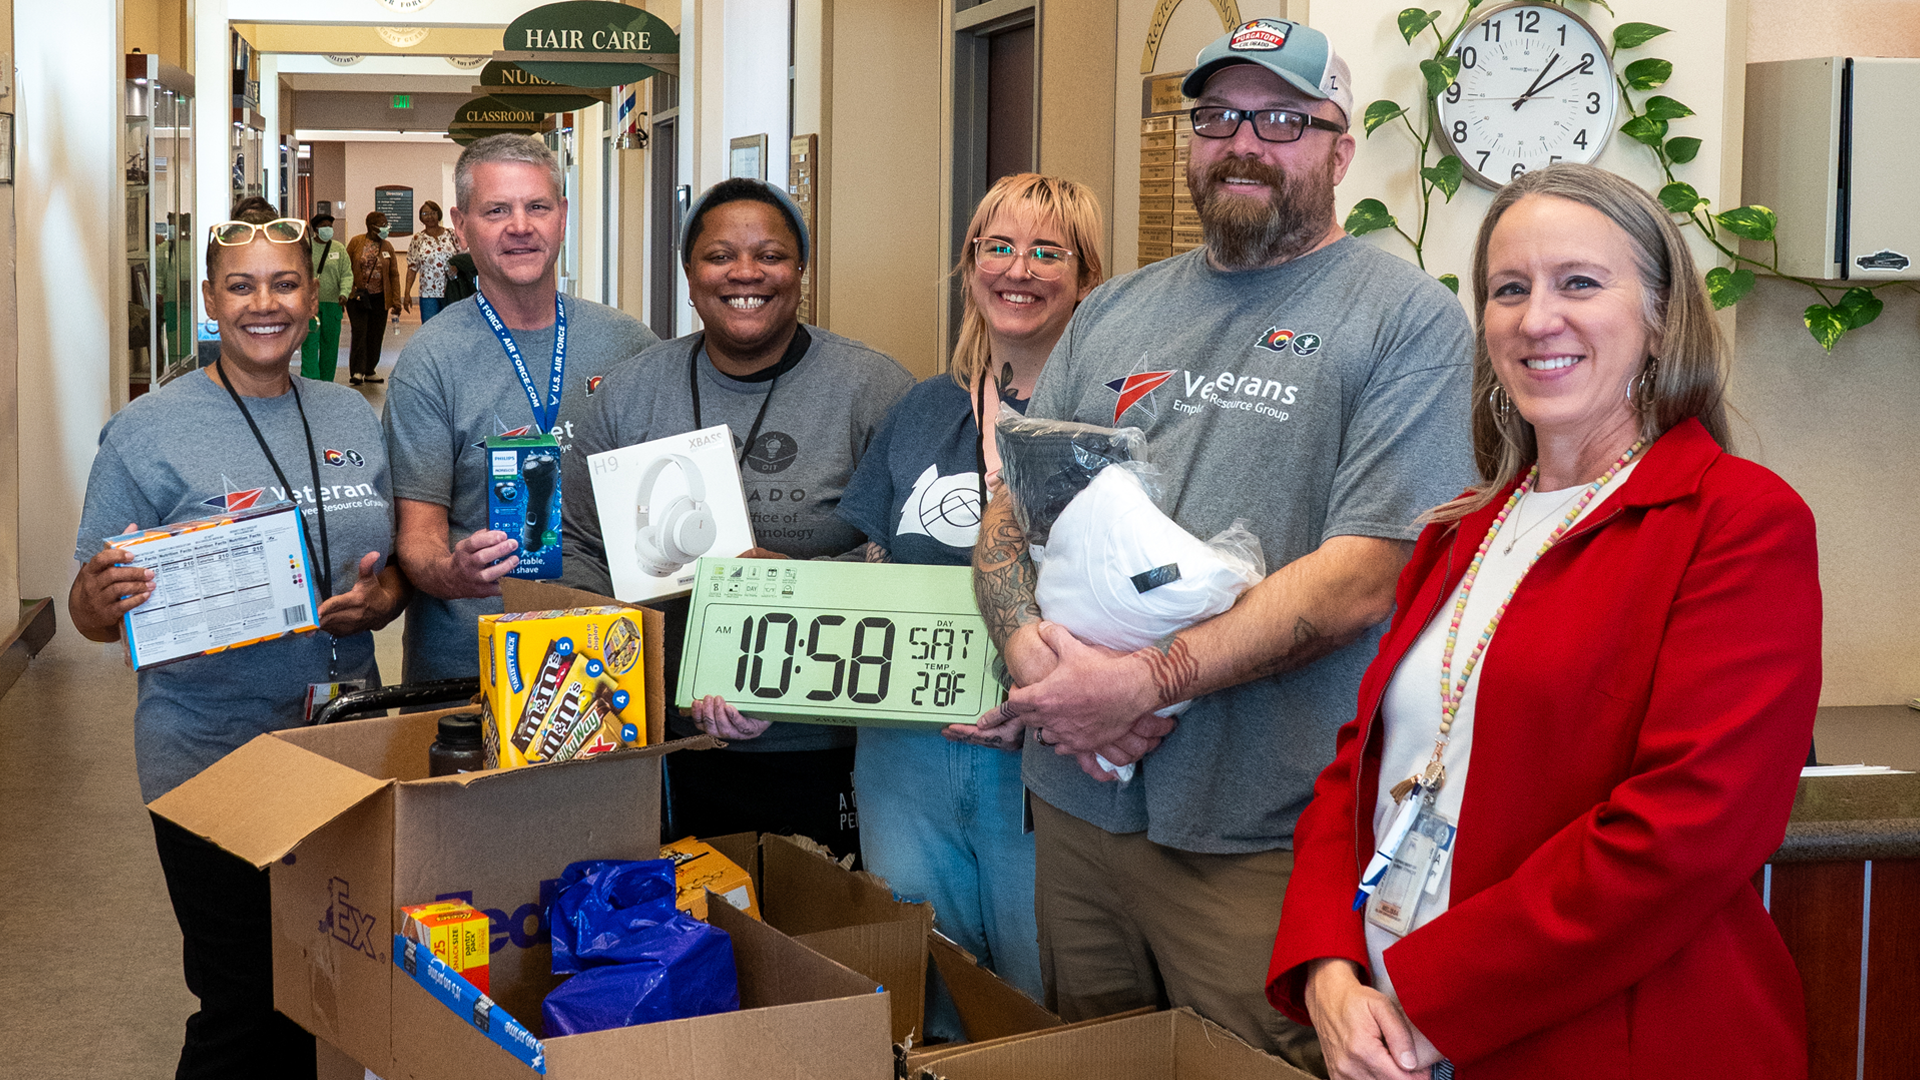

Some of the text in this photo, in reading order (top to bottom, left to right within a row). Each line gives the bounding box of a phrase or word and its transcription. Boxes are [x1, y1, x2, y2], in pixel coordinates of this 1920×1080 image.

[1481, 19, 1501, 42] 11
[1515, 10, 1540, 33] 12
[525, 29, 651, 50] HAIR CARE
[1235, 31, 1280, 43] PURGATORY
[1557, 24, 1567, 46] 1
[1579, 53, 1595, 75] 2
[394, 95, 410, 108] EXIT
[1446, 81, 1461, 104] 9
[1586, 92, 1601, 114] 3
[466, 110, 535, 122] CLASSROOM
[1452, 120, 1468, 143] 8
[1573, 129, 1588, 150] 4
[1476, 150, 1491, 172] 7
[1511, 163, 1526, 182] 6
[556, 325, 565, 355] FORCE
[482, 304, 504, 332] FORCE
[503, 338, 516, 353] AIR
[512, 354, 540, 408] FORCE.COM
[554, 356, 563, 372] AIR
[552, 374, 561, 392] U.S.
[1184, 370, 1299, 404] Veerans
[1209, 392, 1253, 412] Resource
[1254, 402, 1289, 422] Group
[688, 432, 722, 449] XBASS
[593, 456, 619, 475] H9
[323, 500, 362, 513] Resource
[783, 512, 799, 523] of
[715, 625, 732, 634] AM
[560, 642, 570, 650] 5
[909, 627, 974, 661] SAT
[508, 635, 519, 690] VARIETY PACK
[734, 612, 896, 703] 10:58
[589, 664, 600, 673] 6
[615, 695, 626, 704] 4
[573, 710, 601, 743] Way
[624, 728, 635, 737] 7
[434, 940, 446, 956] 25
